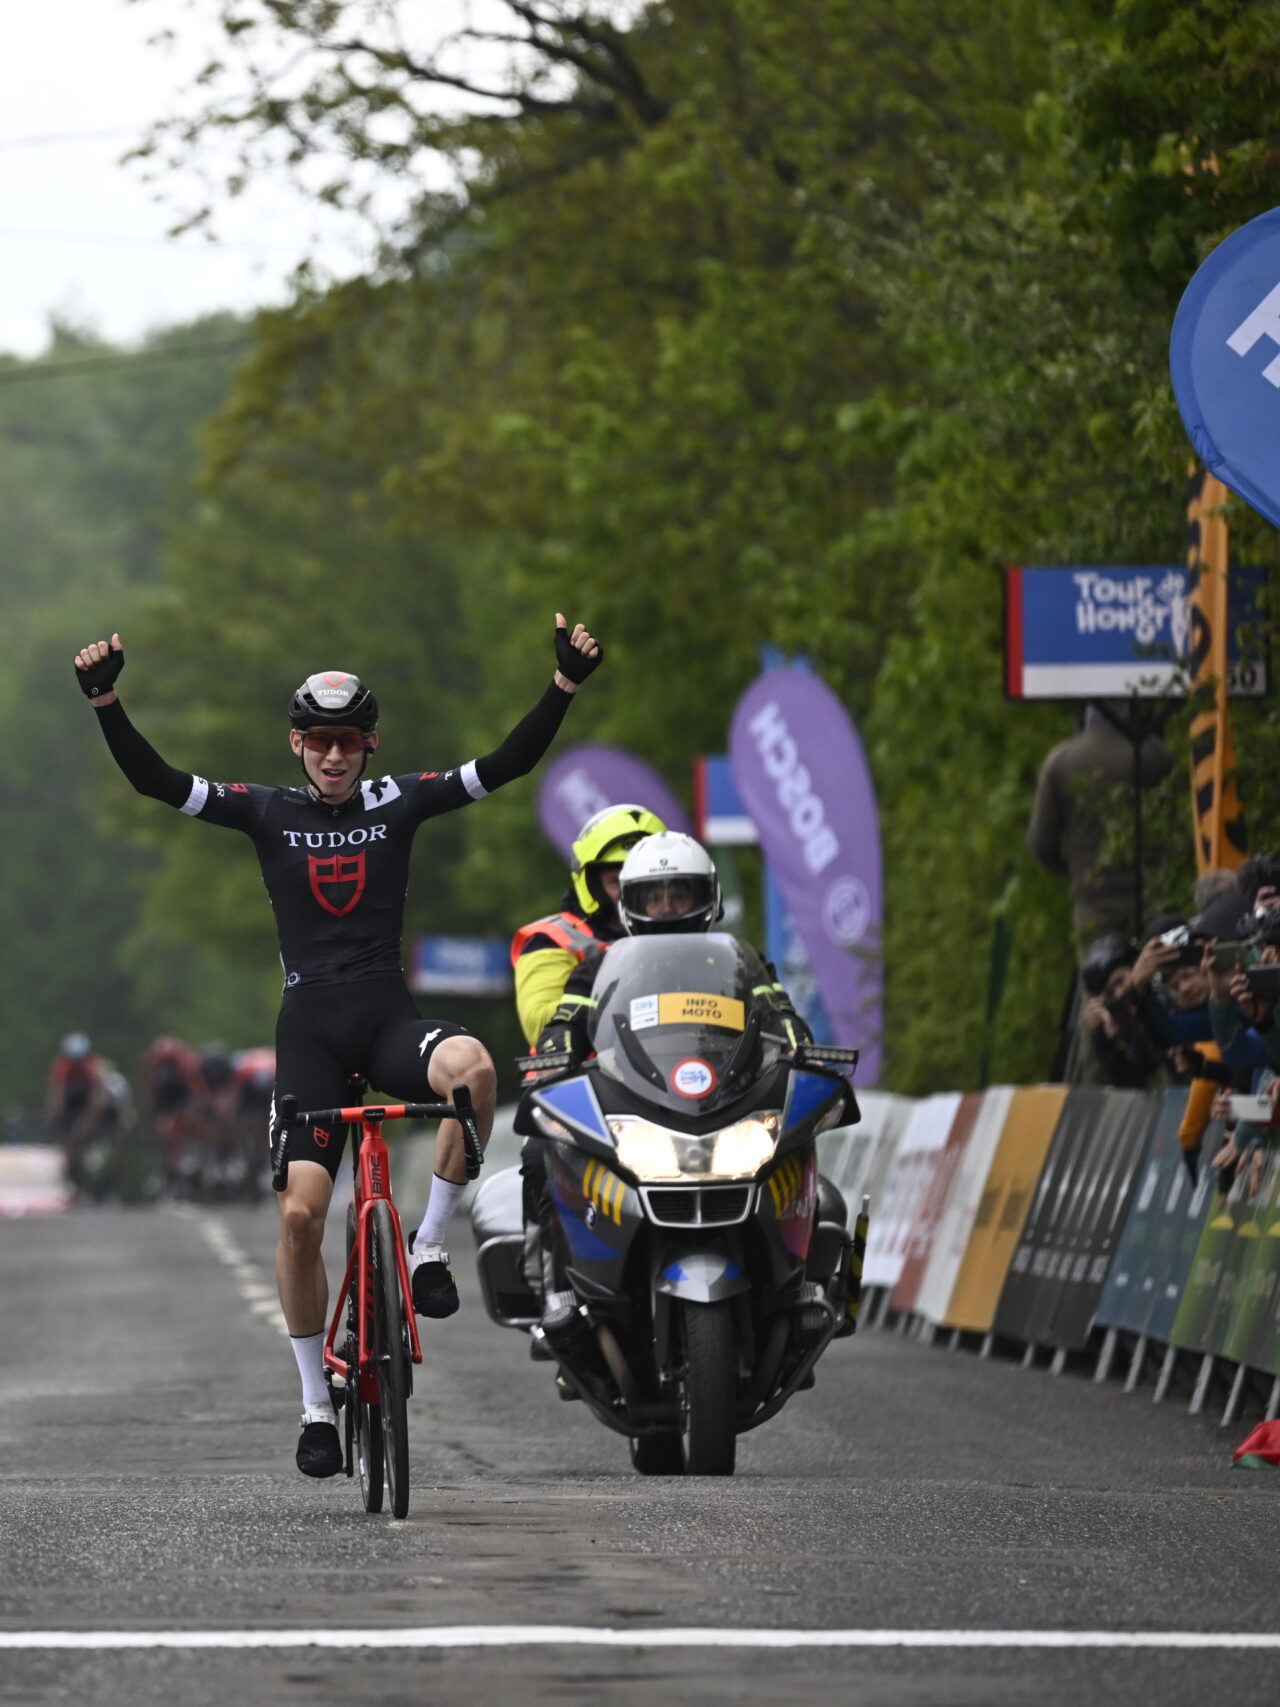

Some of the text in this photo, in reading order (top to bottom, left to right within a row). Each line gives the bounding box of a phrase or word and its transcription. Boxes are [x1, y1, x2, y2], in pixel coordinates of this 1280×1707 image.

[1073, 571, 1152, 604] Tour
[317, 689, 349, 697] TUDOR
[282, 824, 388, 848] TUDOR
[686, 998, 718, 1008] INFO
[682, 1008, 722, 1019] MOTO
[371, 1153, 383, 1195] BMC
